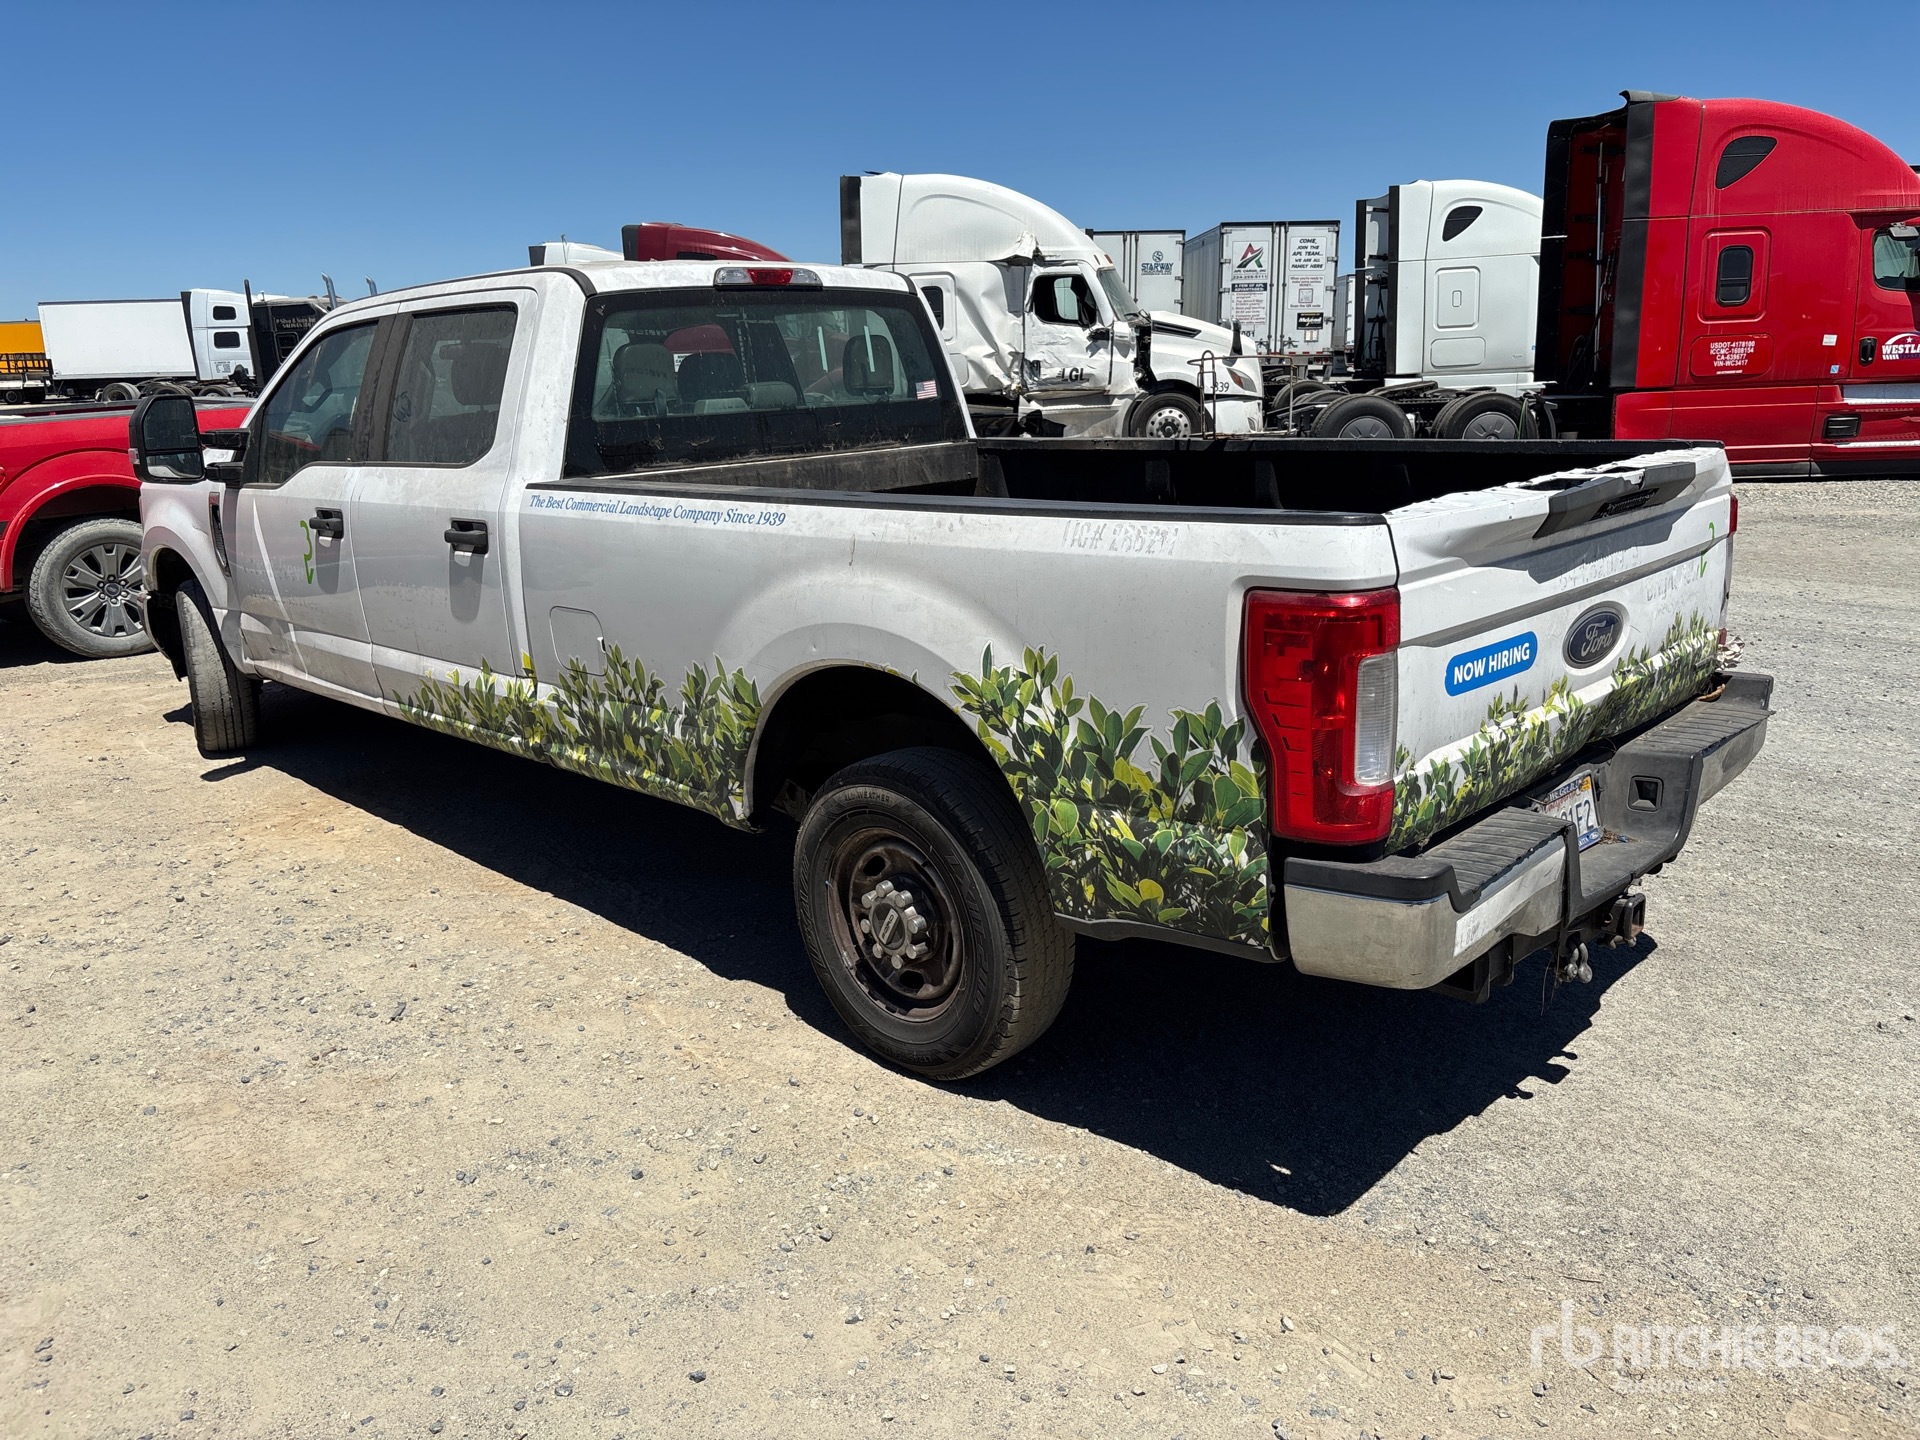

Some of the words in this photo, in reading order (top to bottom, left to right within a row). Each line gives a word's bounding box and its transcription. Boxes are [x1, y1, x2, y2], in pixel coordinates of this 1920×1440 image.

[1141, 262, 1174, 271] STARWAY
[530, 495, 544, 508] The
[545, 496, 565, 509] Best
[565, 497, 620, 514] Commercial
[619, 501, 672, 520] Landscape
[673, 504, 724, 525] Company
[723, 508, 755, 524] Since
[756, 511, 787, 527] 1939
[1581, 620, 1614, 657] Ford
[1454, 657, 1486, 685] NOW
[1488, 642, 1530, 674] HIRING
